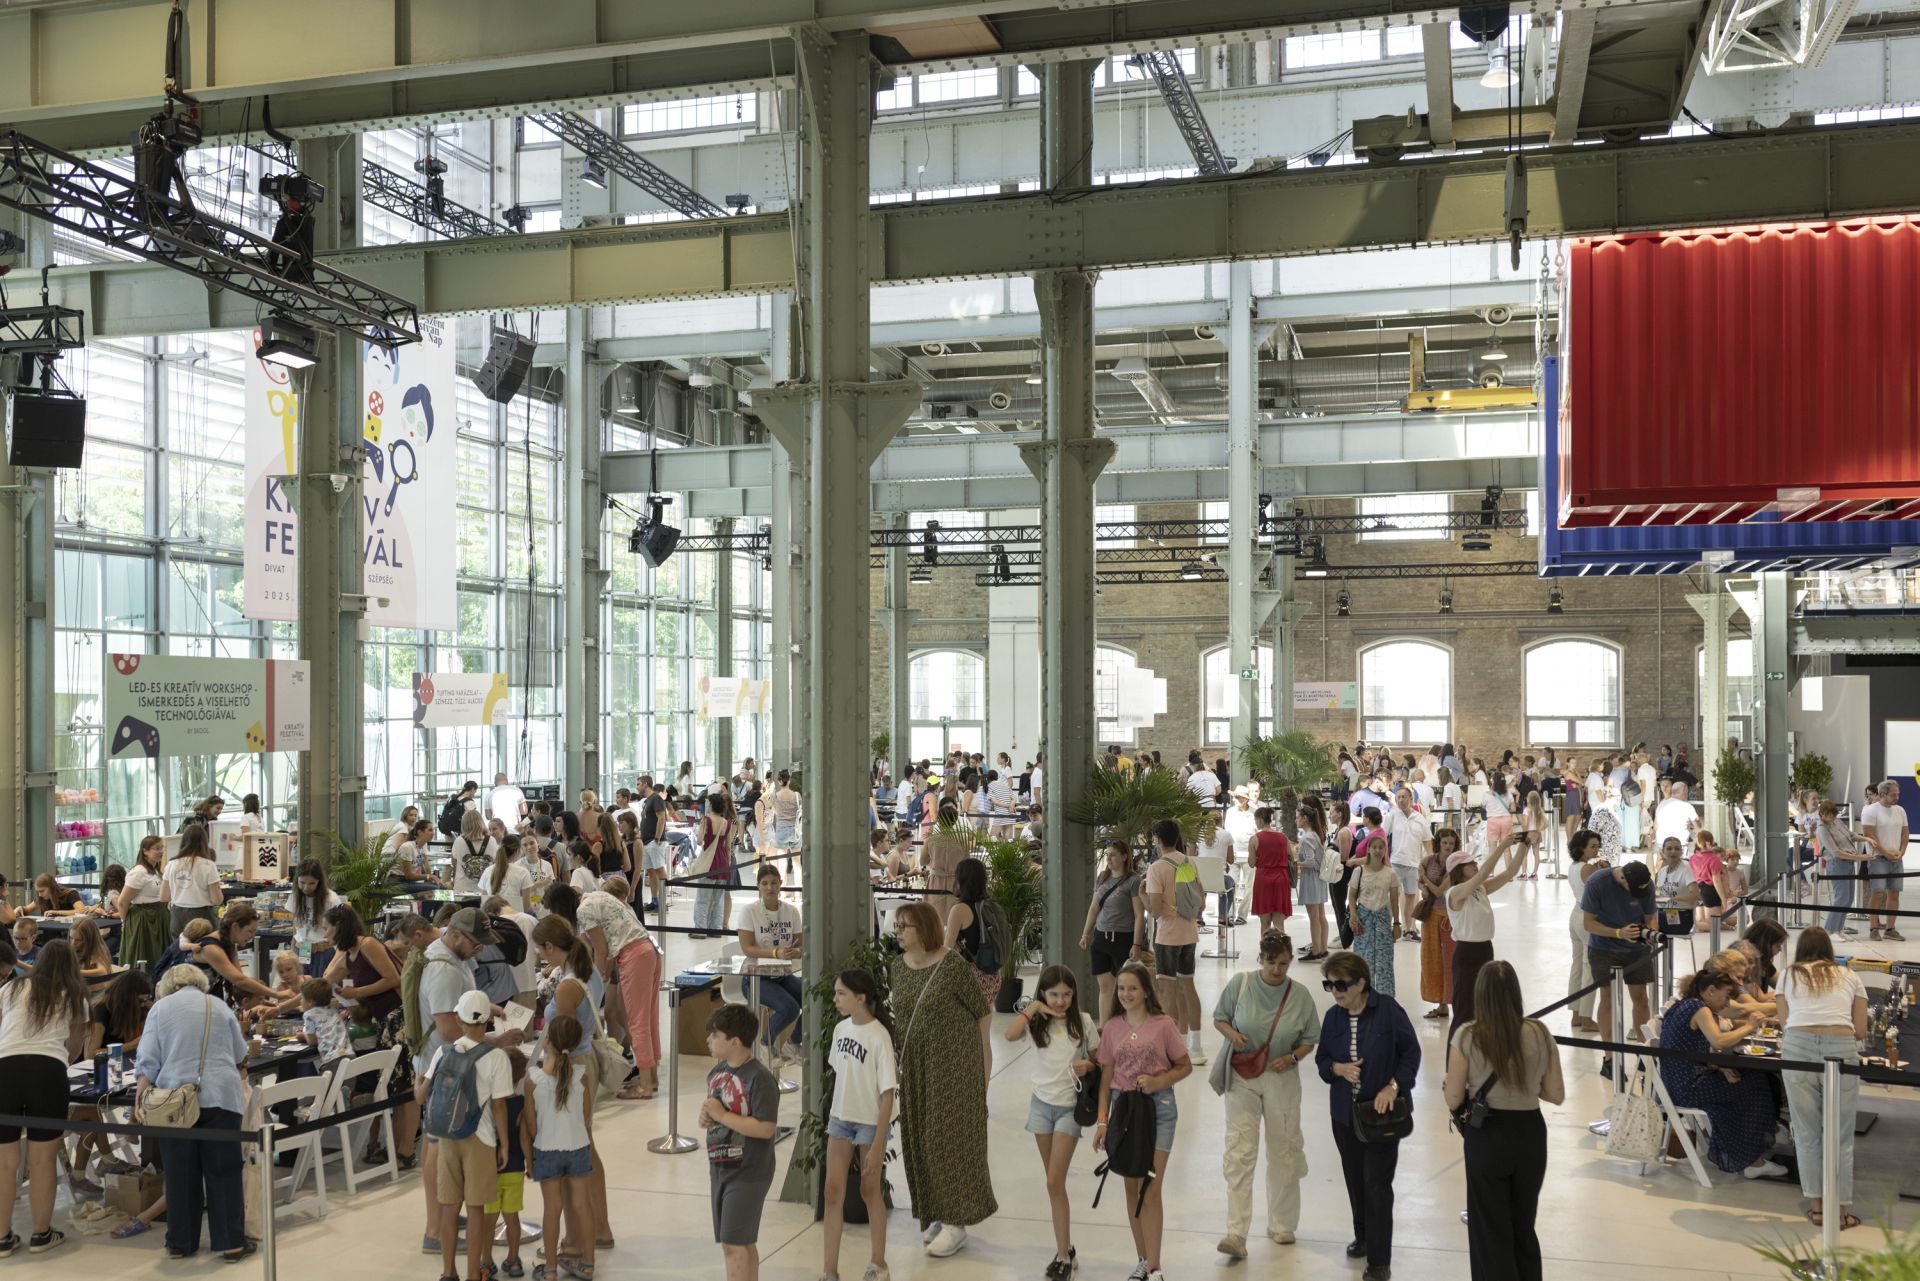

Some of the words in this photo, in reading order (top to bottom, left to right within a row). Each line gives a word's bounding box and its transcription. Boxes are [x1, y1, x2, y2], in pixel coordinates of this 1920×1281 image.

[419, 322, 439, 336] stván
[429, 332, 443, 348] Nap
[264, 563, 285, 574] DIVAT
[368, 574, 394, 585] SZÉPSÉG
[129, 682, 161, 693] LED-ES
[164, 680, 201, 693] KREATÍV
[204, 683, 253, 693] WORKSHOP
[138, 694, 195, 707] ISMERKEDÉS
[197, 697, 204, 707] A
[205, 694, 250, 707] VISELHETŐ
[155, 708, 236, 721] TECHNOLÓGIÁVAL
[769, 920, 792, 928] Szent
[780, 933, 791, 941] ap
